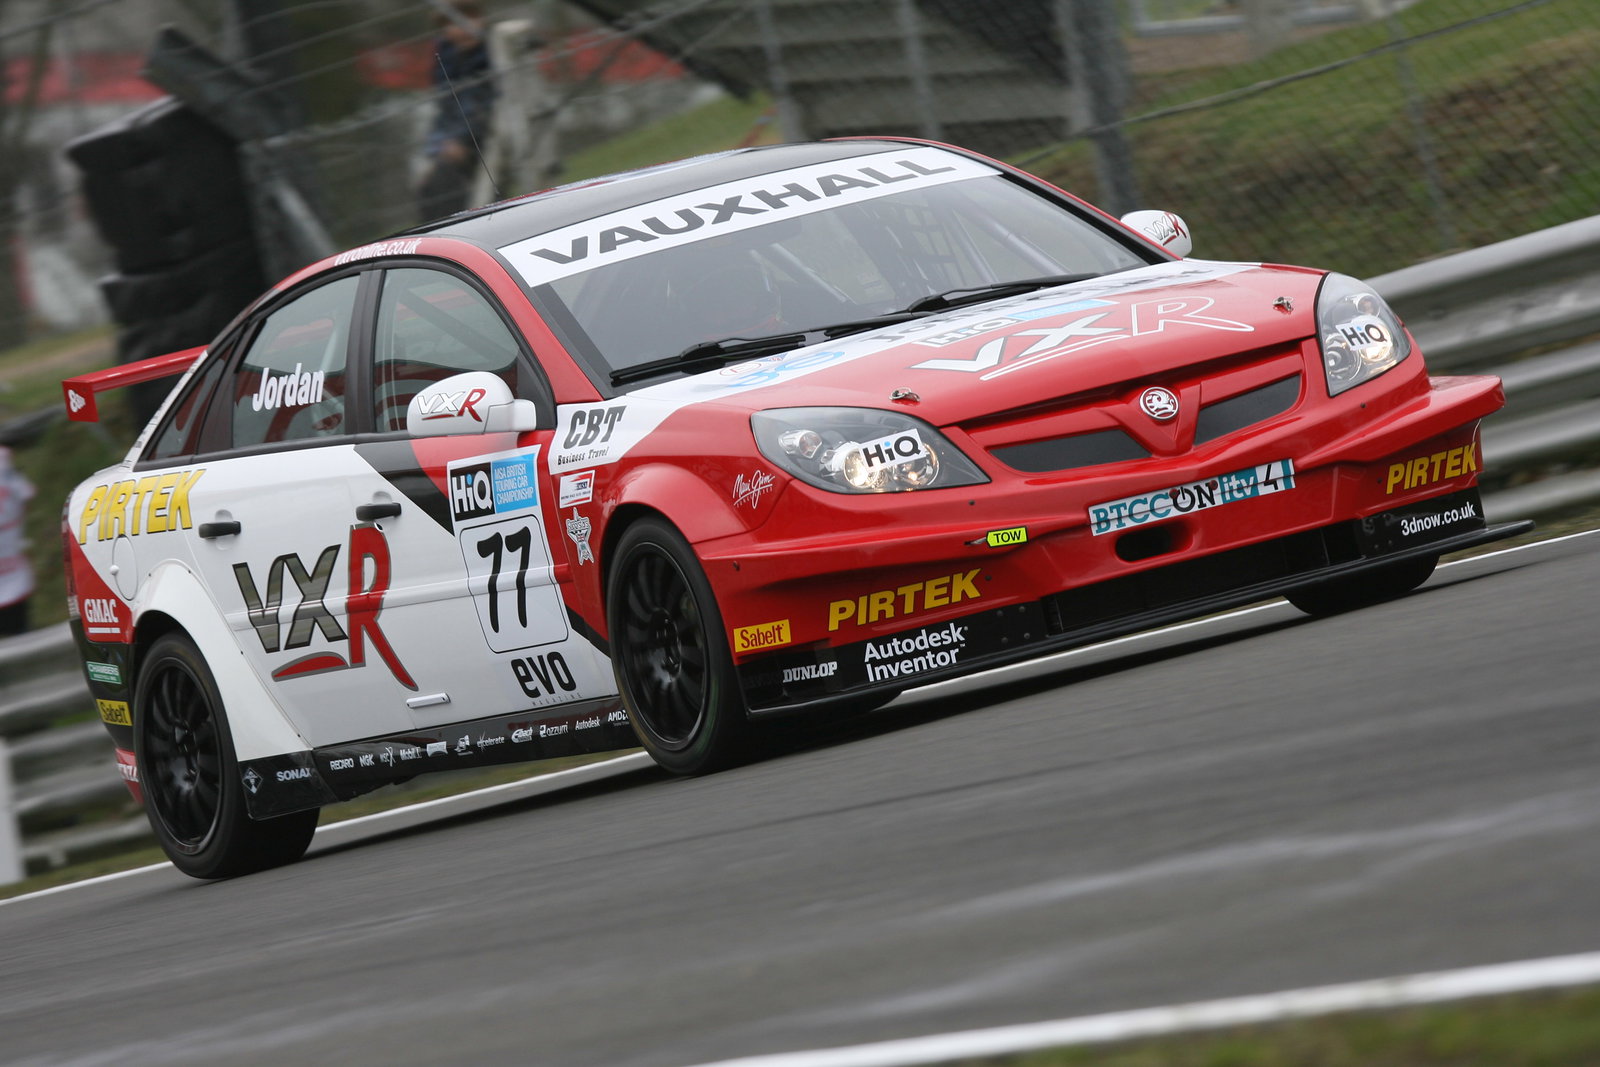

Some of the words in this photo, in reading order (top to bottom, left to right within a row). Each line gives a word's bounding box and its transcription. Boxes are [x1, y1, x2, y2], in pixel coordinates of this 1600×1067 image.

[529, 159, 957, 265] VAUXHALL
[906, 296, 1255, 373] VXR
[1341, 323, 1388, 347] HiQ
[252, 362, 325, 412] Jordan
[416, 388, 487, 423] VXR
[563, 405, 627, 450] CBT
[557, 452, 586, 466] Business
[588, 446, 610, 460] Travel
[863, 435, 923, 468] HiQ
[1385, 442, 1477, 495] PIRTEK
[452, 470, 493, 514] HiQ
[495, 477, 517, 493] TOURING
[517, 475, 529, 488] CAR
[79, 469, 206, 546] PIRTEK
[1401, 500, 1476, 537] 3dnow.co.uk
[993, 529, 1022, 544] TOW
[476, 525, 532, 634] 77
[828, 568, 982, 632] PIRTEK
[84, 598, 119, 623] GMAC
[232, 523, 419, 692] VXR
[739, 622, 786, 649] Sabelt
[864, 622, 966, 663] Autodesk
[511, 651, 577, 699] evo
[782, 661, 838, 683] DUNLOP
[866, 645, 960, 683] Inventor
[276, 767, 313, 782] SONAX
[359, 753, 375, 768] NGK
[575, 716, 601, 731] Autodesk
